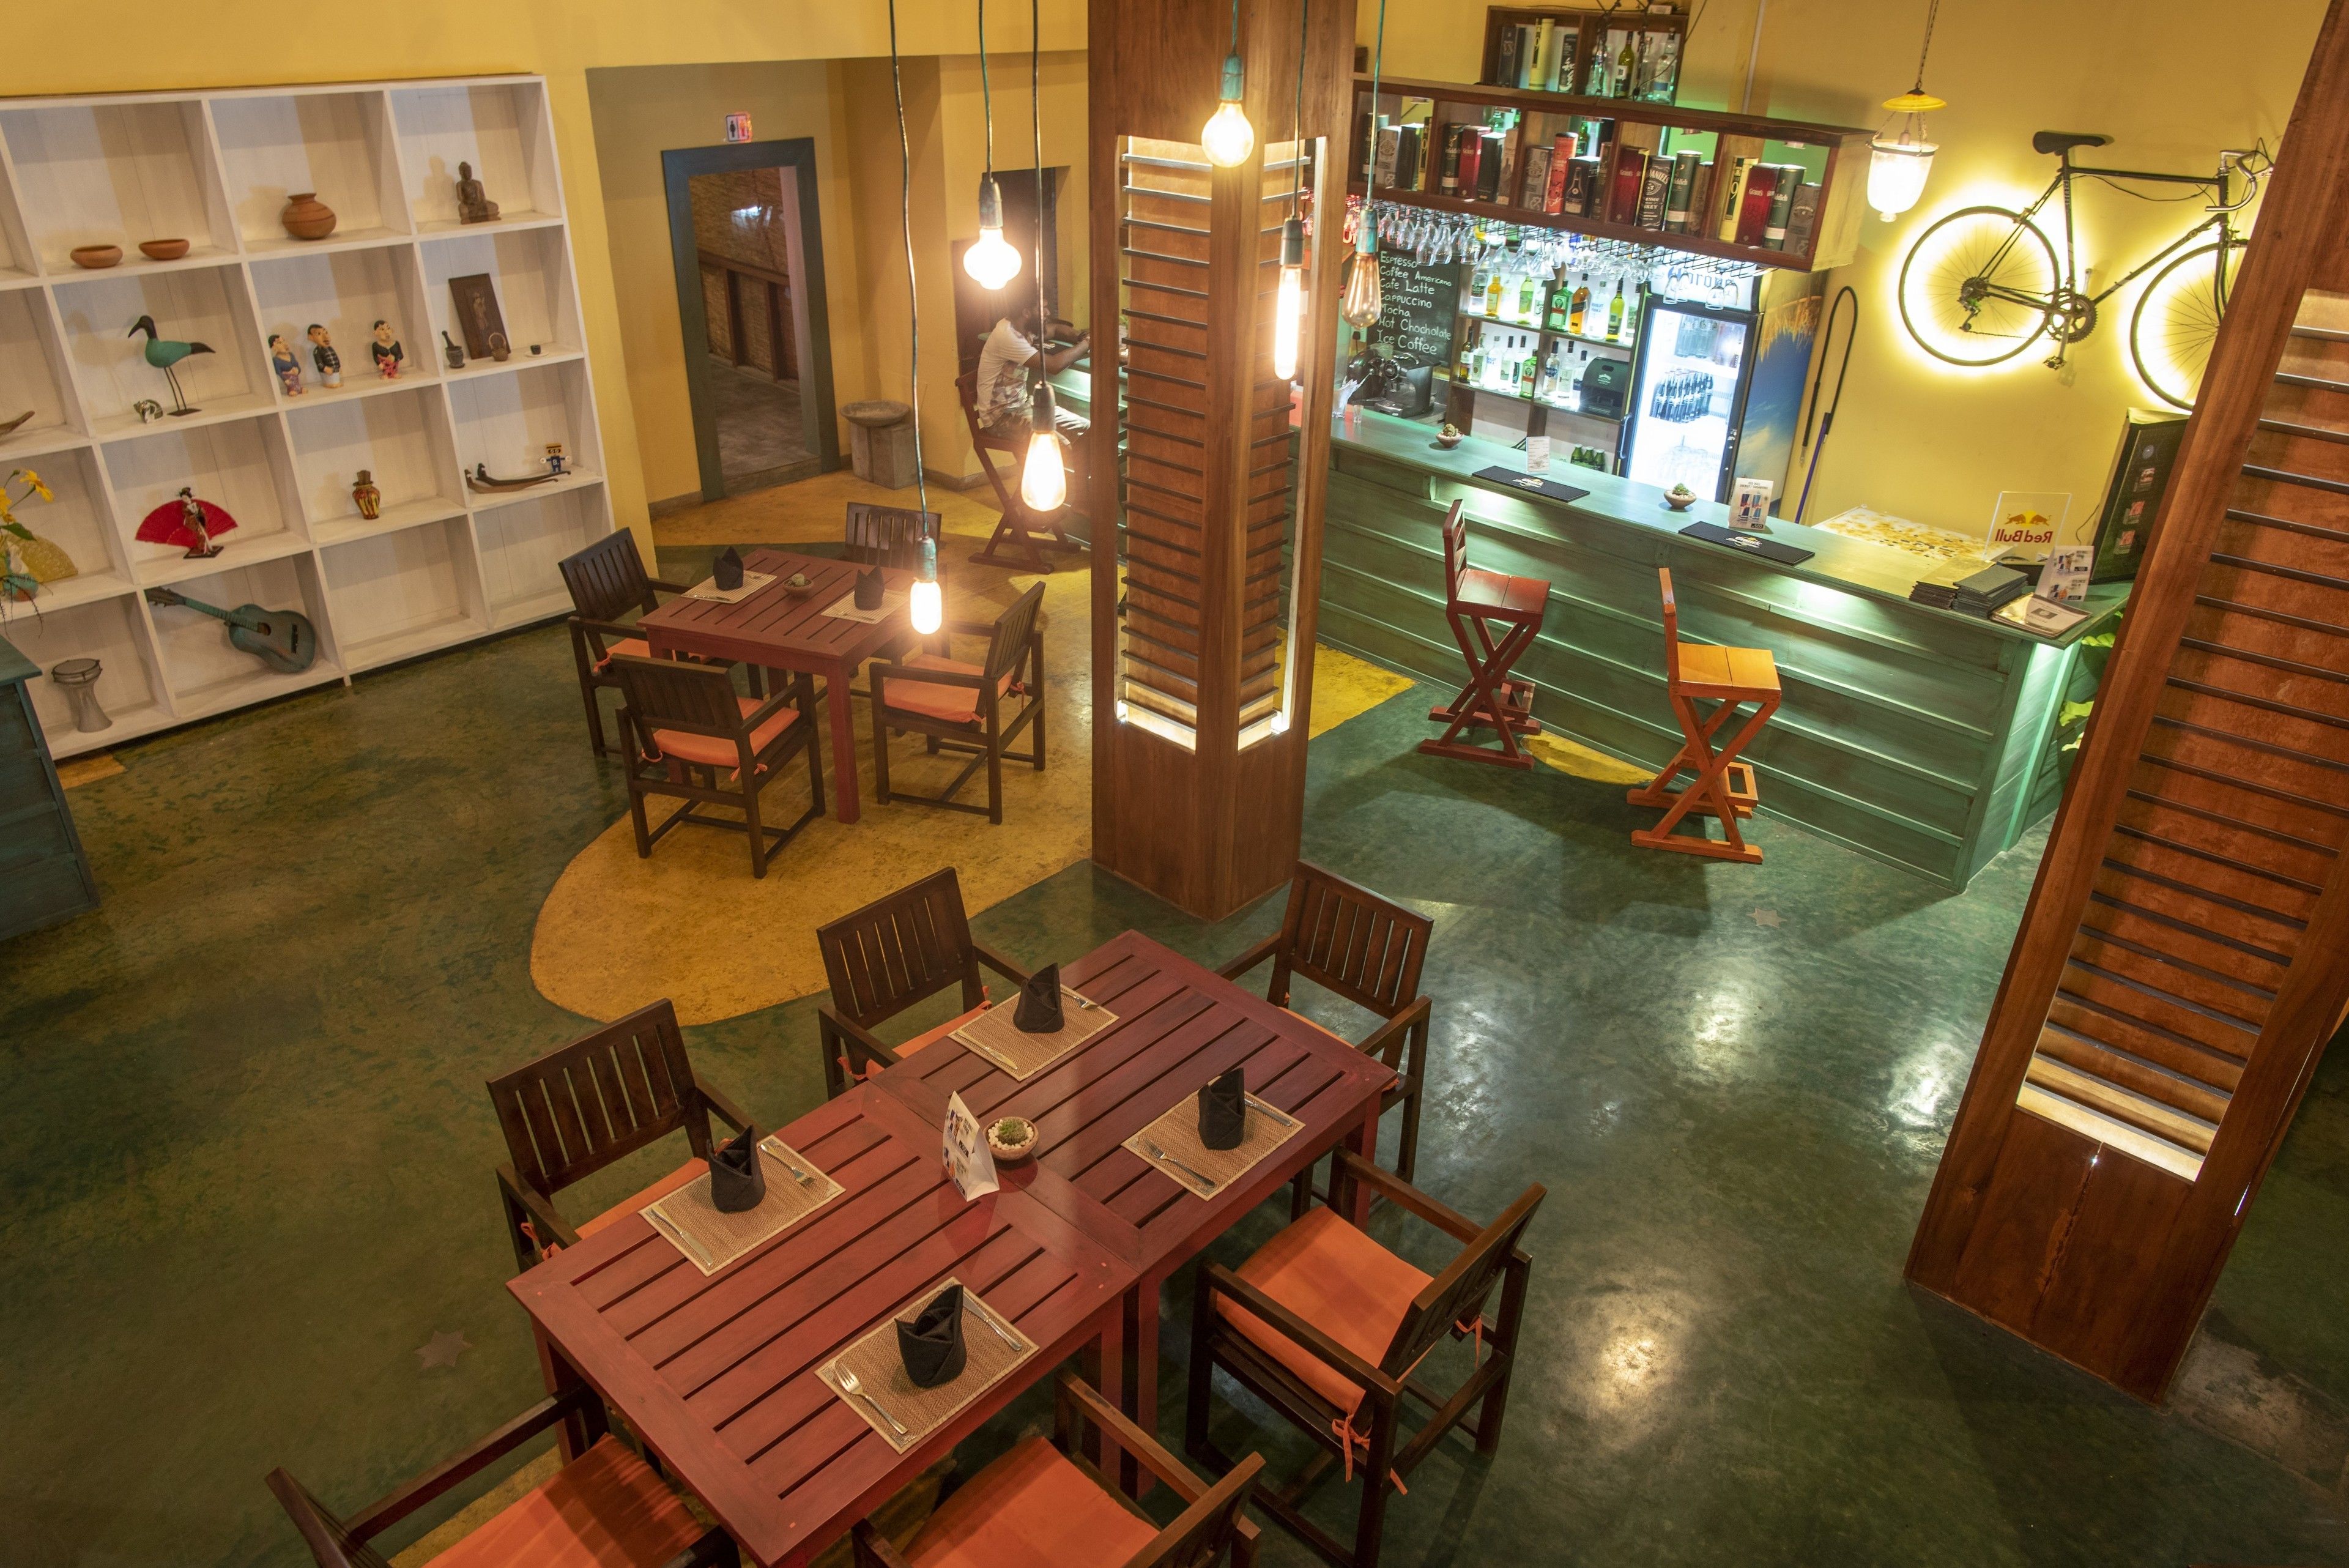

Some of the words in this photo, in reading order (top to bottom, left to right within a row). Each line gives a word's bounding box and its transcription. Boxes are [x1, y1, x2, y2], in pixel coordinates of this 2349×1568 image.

[1380, 251, 1418, 268] Espresso
[1379, 266, 1409, 278] Coffee
[1415, 271, 1452, 286] Americano
[1379, 278, 1400, 289] Cafe
[1405, 280, 1435, 294] Latte
[1378, 316, 1395, 329] Hot
[1400, 319, 1452, 340] Chocholate
[1377, 329, 1395, 344] Ice
[1398, 335, 1438, 355] Coffee
